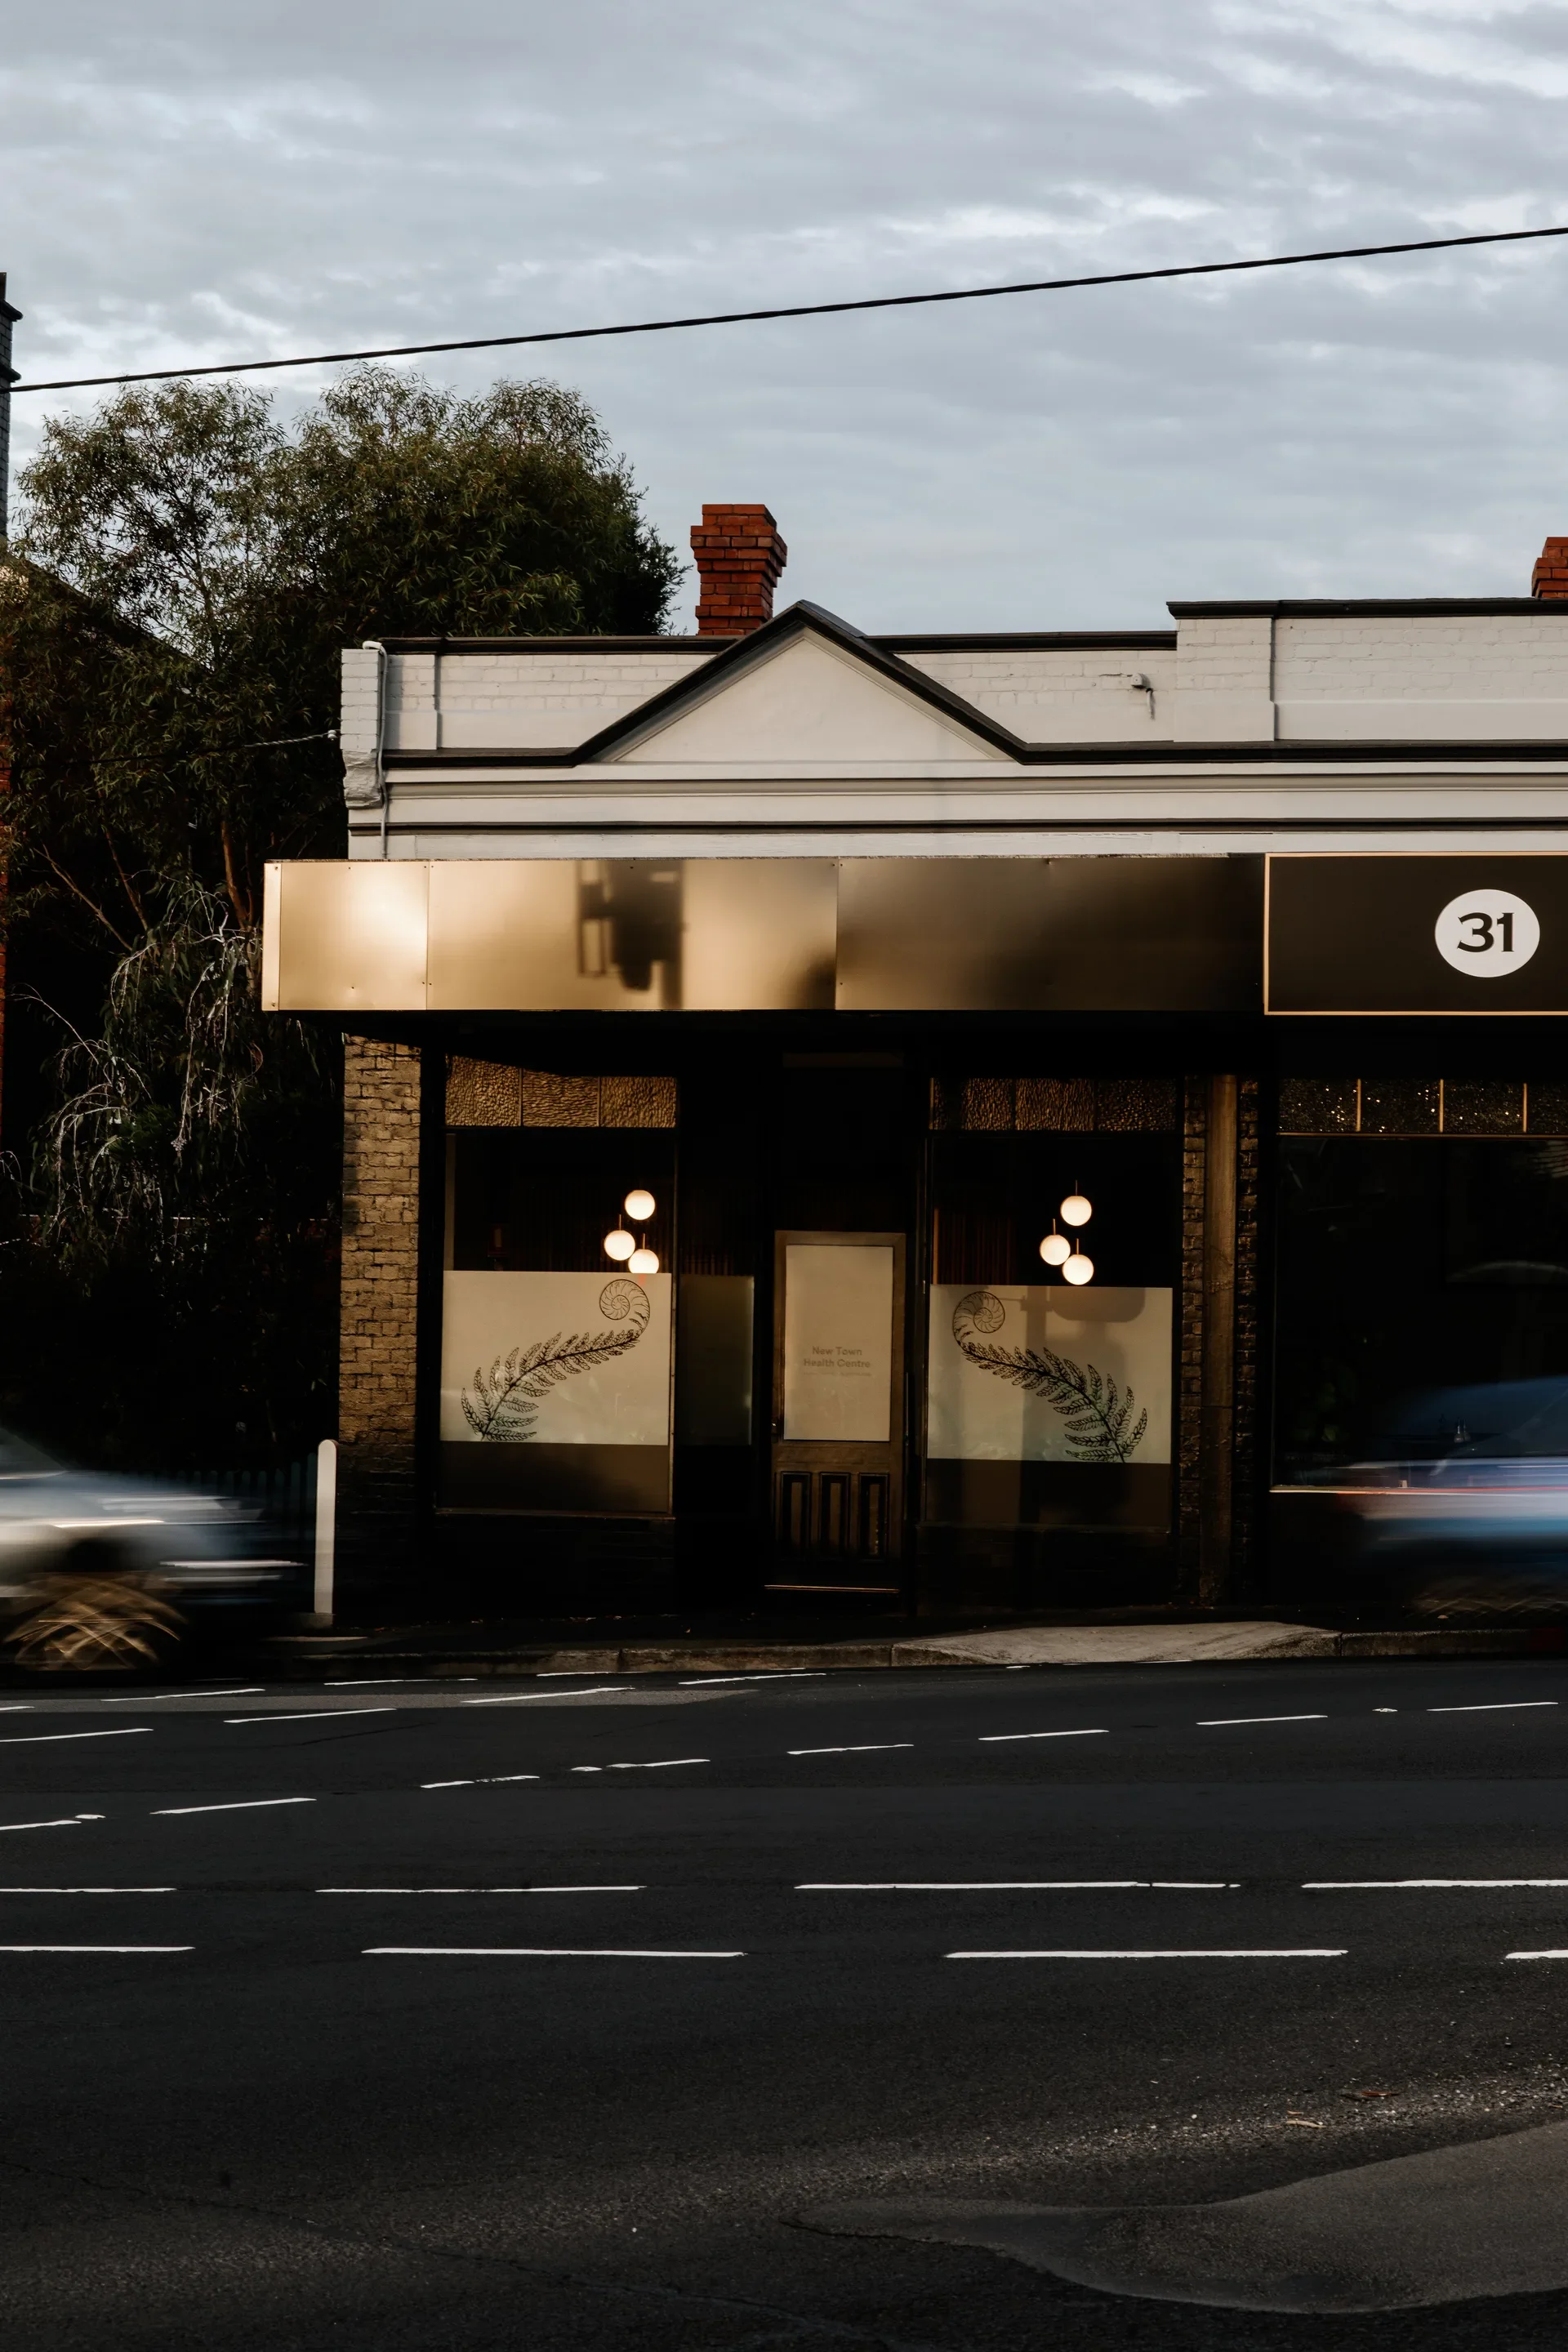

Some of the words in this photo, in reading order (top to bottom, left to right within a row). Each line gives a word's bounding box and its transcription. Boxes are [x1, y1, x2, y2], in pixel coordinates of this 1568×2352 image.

[1457, 912, 1514, 953] 31
[813, 1346, 833, 1356] New
[835, 1347, 862, 1356] Town
[804, 1358, 835, 1367] Health
[837, 1359, 871, 1368] Centre
